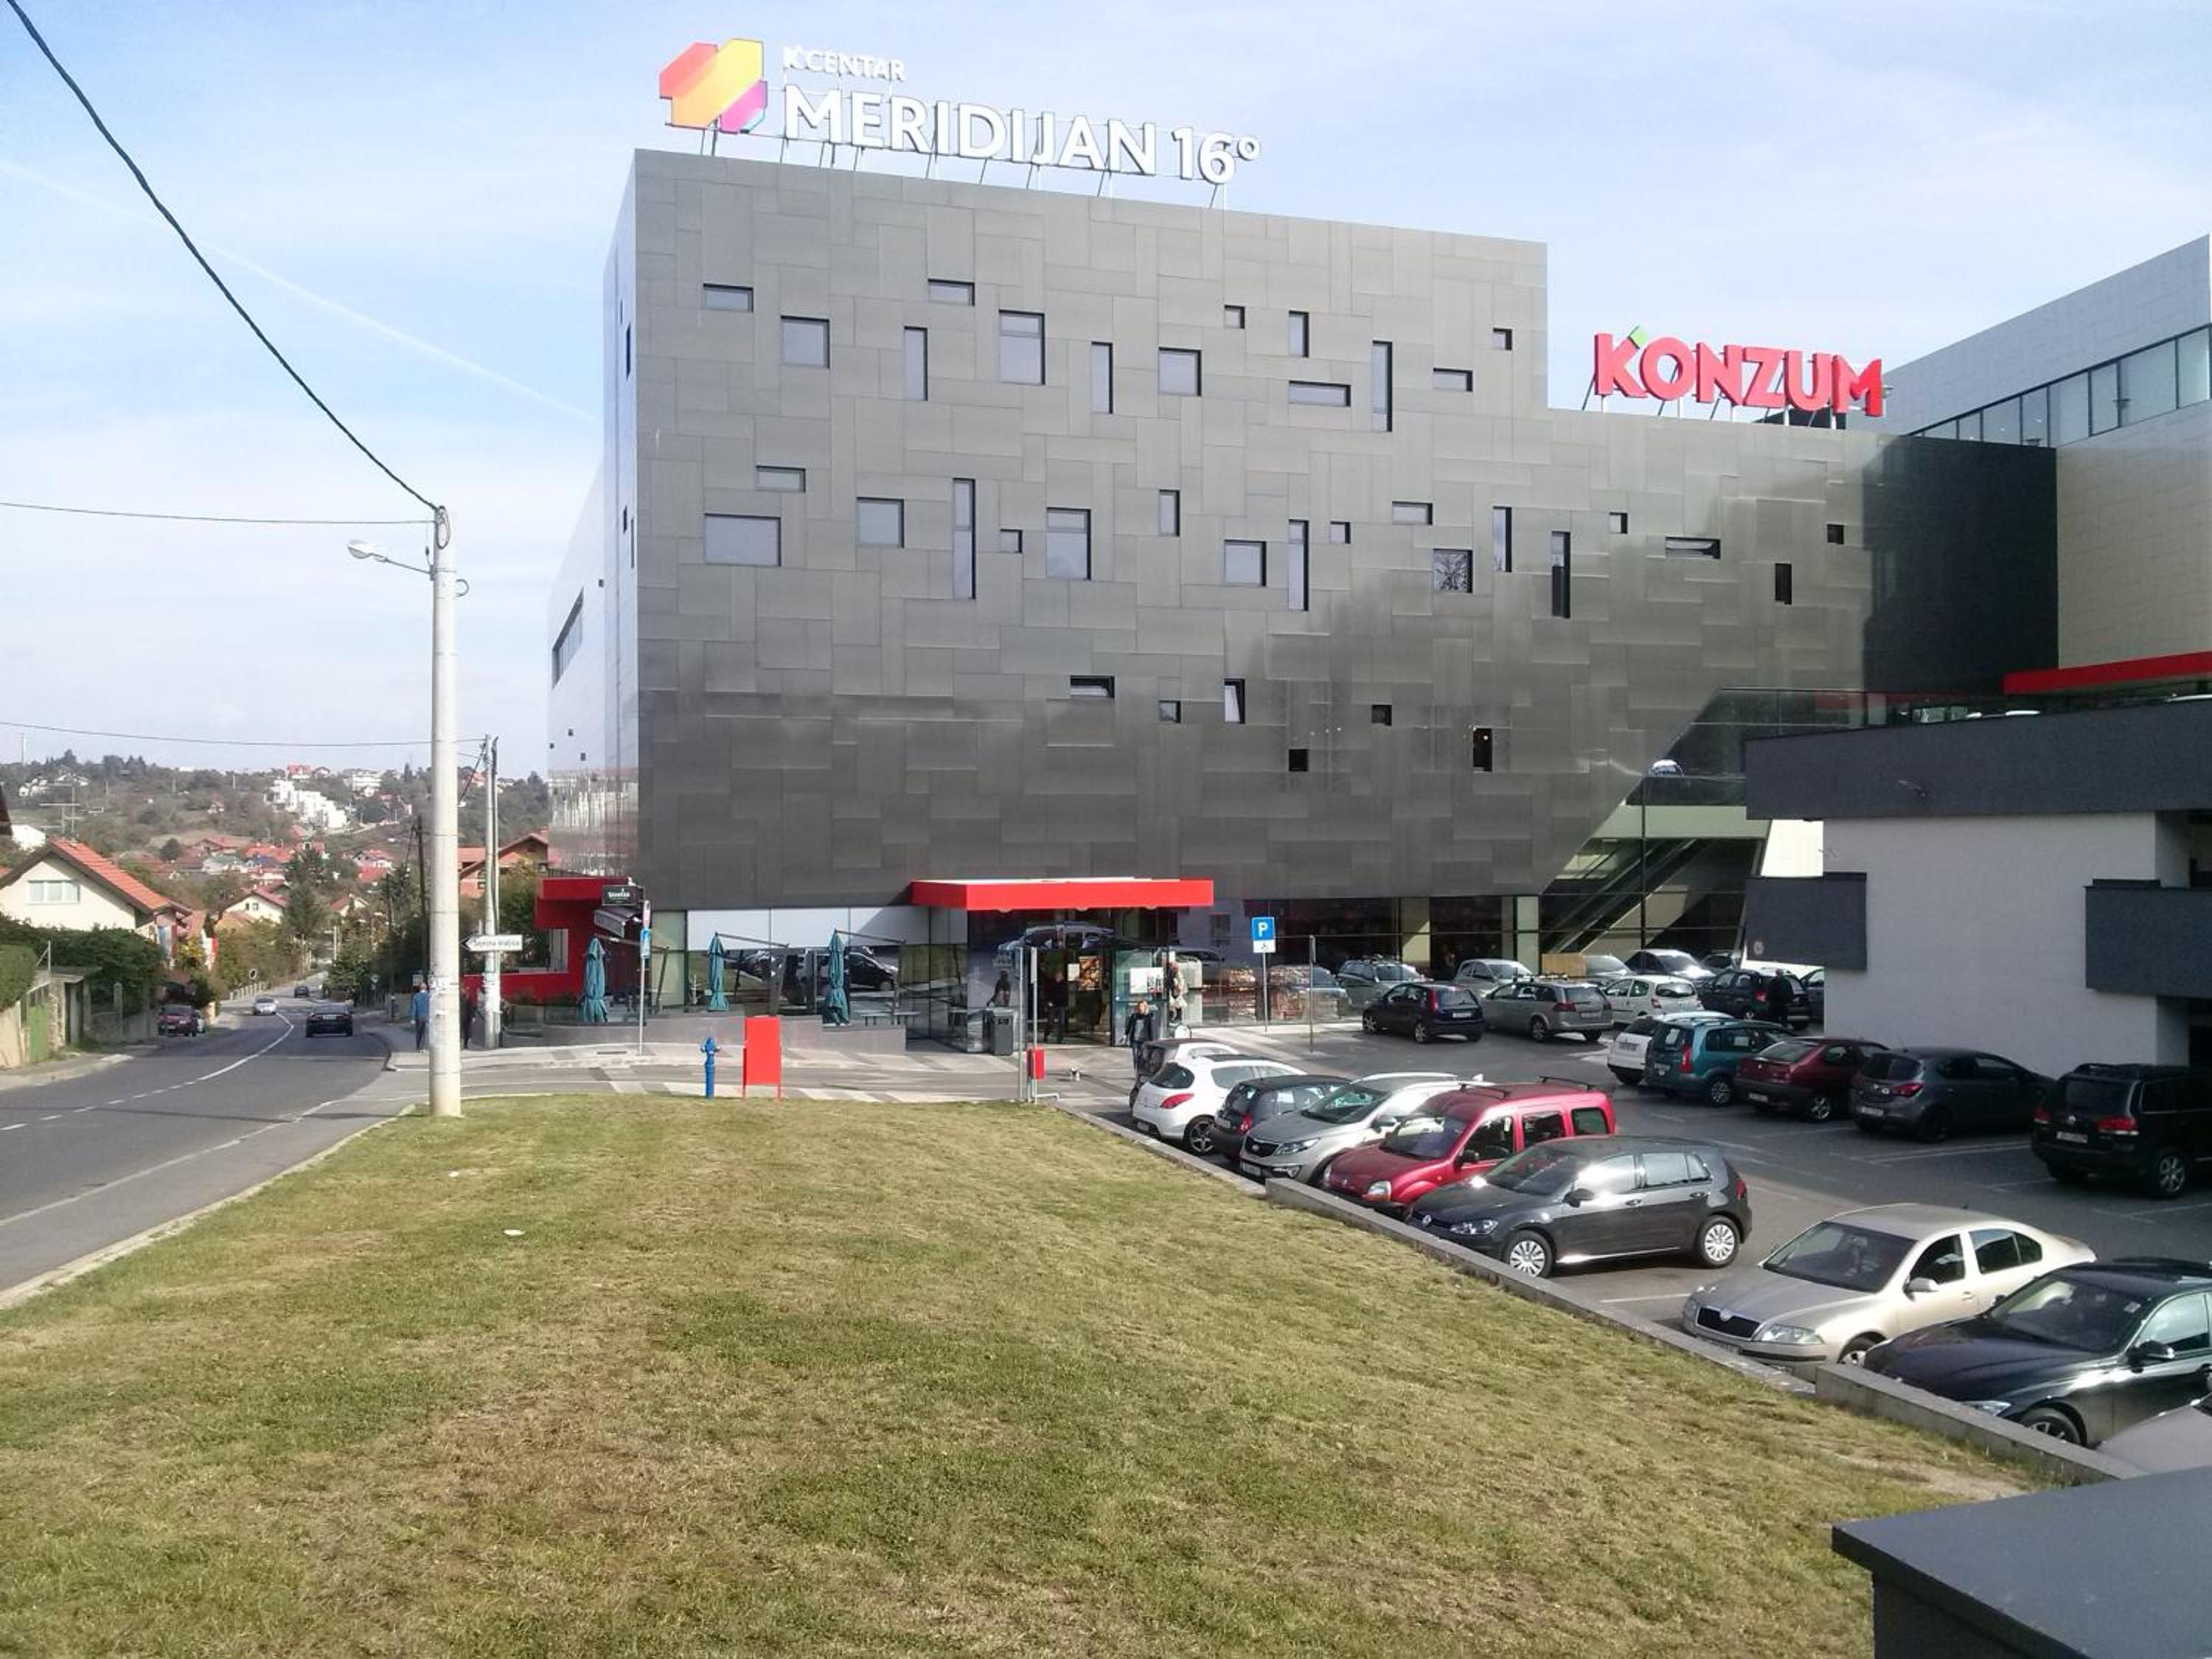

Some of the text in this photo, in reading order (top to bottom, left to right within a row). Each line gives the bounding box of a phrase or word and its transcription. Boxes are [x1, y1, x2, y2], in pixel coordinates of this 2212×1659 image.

[784, 83, 1157, 176] MERIDIJAN
[1593, 327, 1882, 418] KONZUM
[1258, 922, 1269, 937] P
